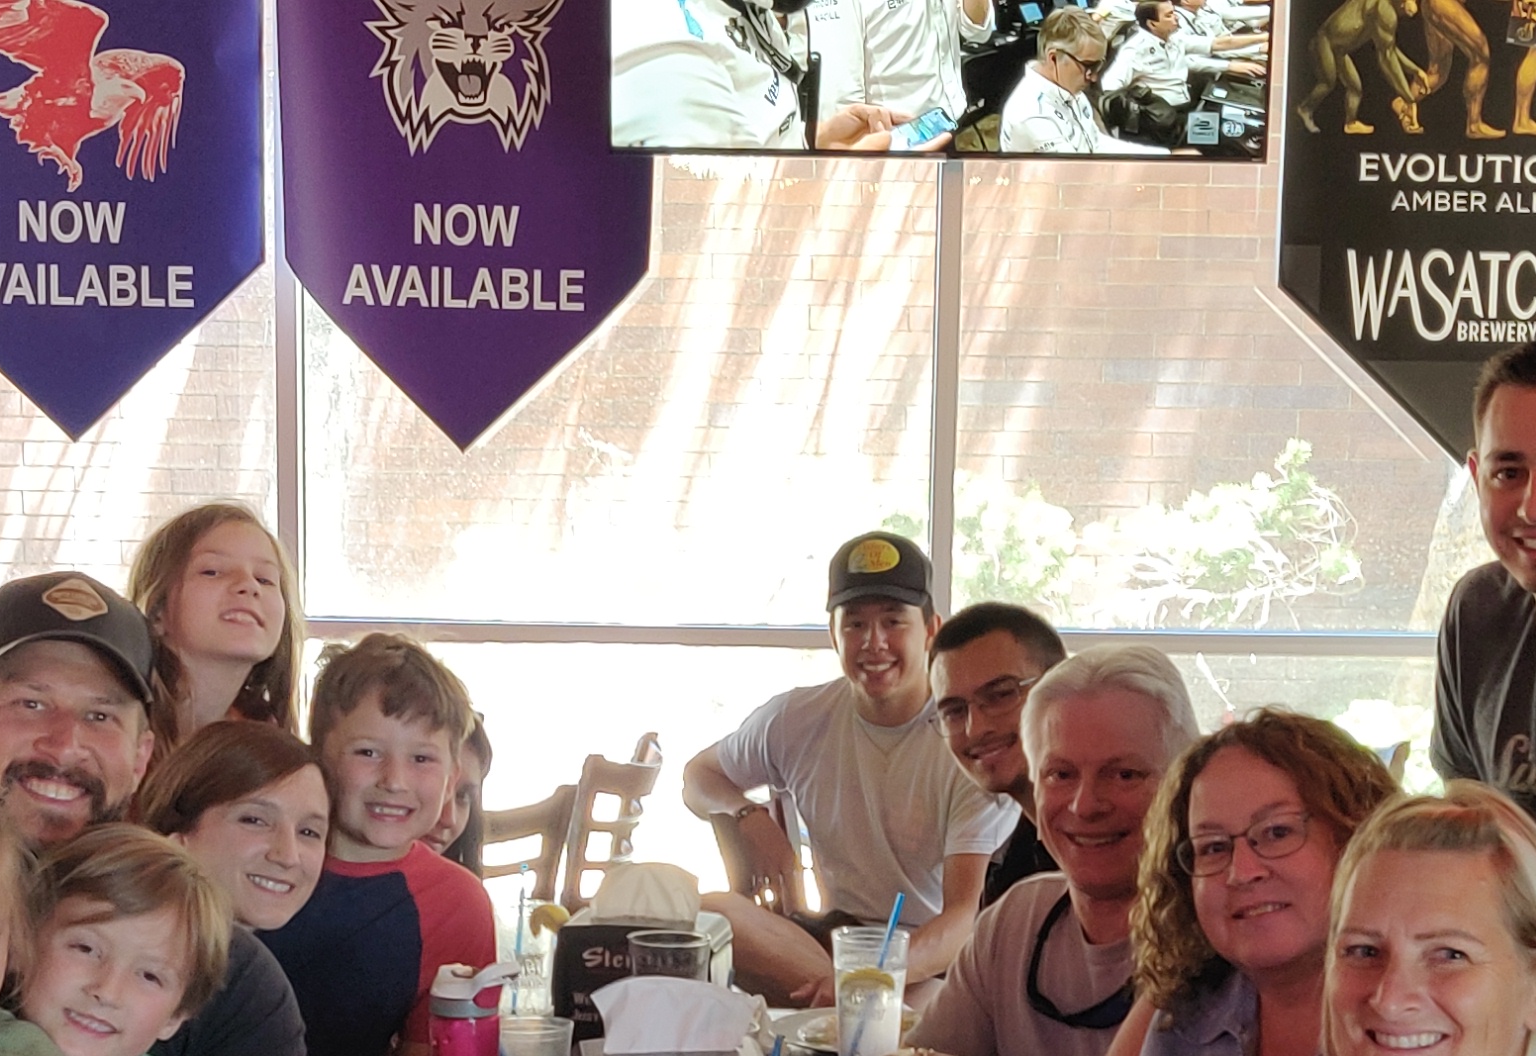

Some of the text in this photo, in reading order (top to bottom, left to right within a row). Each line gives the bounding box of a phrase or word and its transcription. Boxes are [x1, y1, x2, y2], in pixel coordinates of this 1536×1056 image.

[17, 200, 127, 245] NOW
[1390, 190, 1487, 213] AMBER
[412, 202, 520, 248] NOW
[342, 263, 586, 311] AVAILABLE
